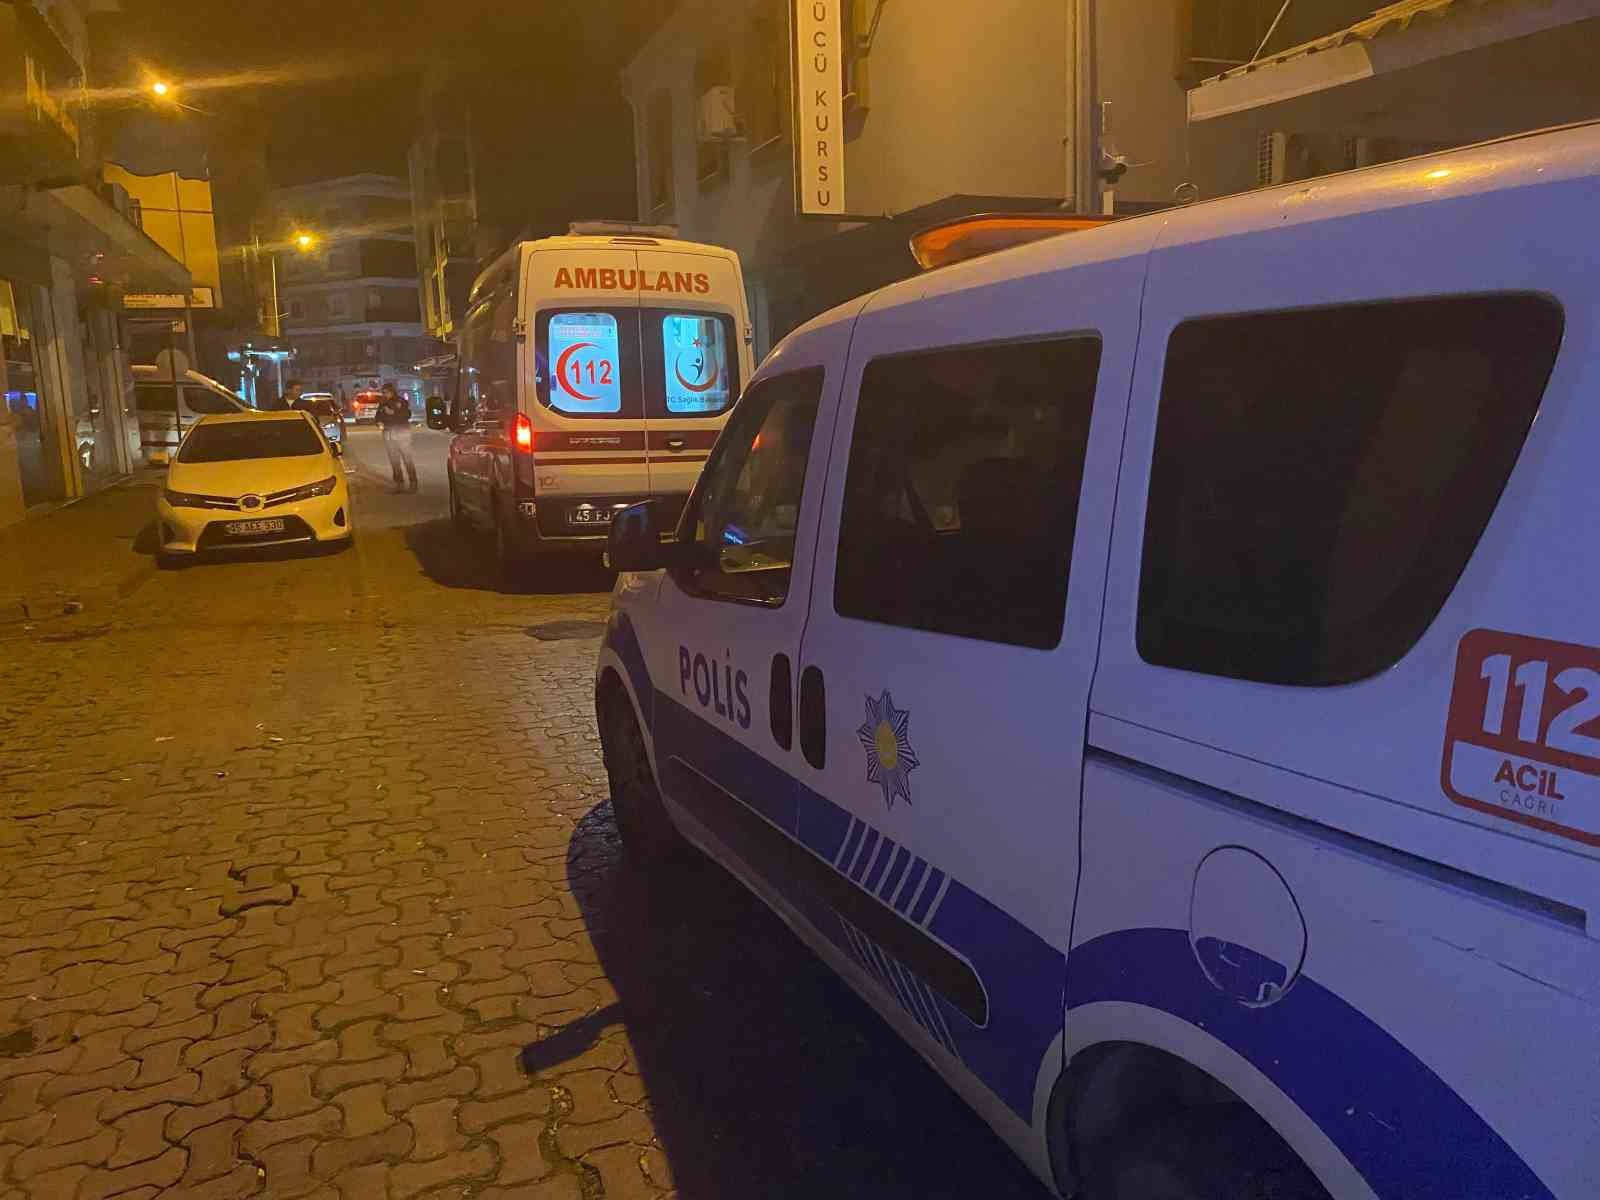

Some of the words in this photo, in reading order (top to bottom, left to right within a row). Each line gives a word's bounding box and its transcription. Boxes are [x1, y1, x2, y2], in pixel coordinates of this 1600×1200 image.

[815, 89, 830, 206] KURSU
[553, 267, 710, 294] AMBULANS
[570, 359, 612, 385] 112
[576, 511, 590, 521] 45
[679, 645, 750, 729] POLİS
[1480, 653, 1600, 759] 112
